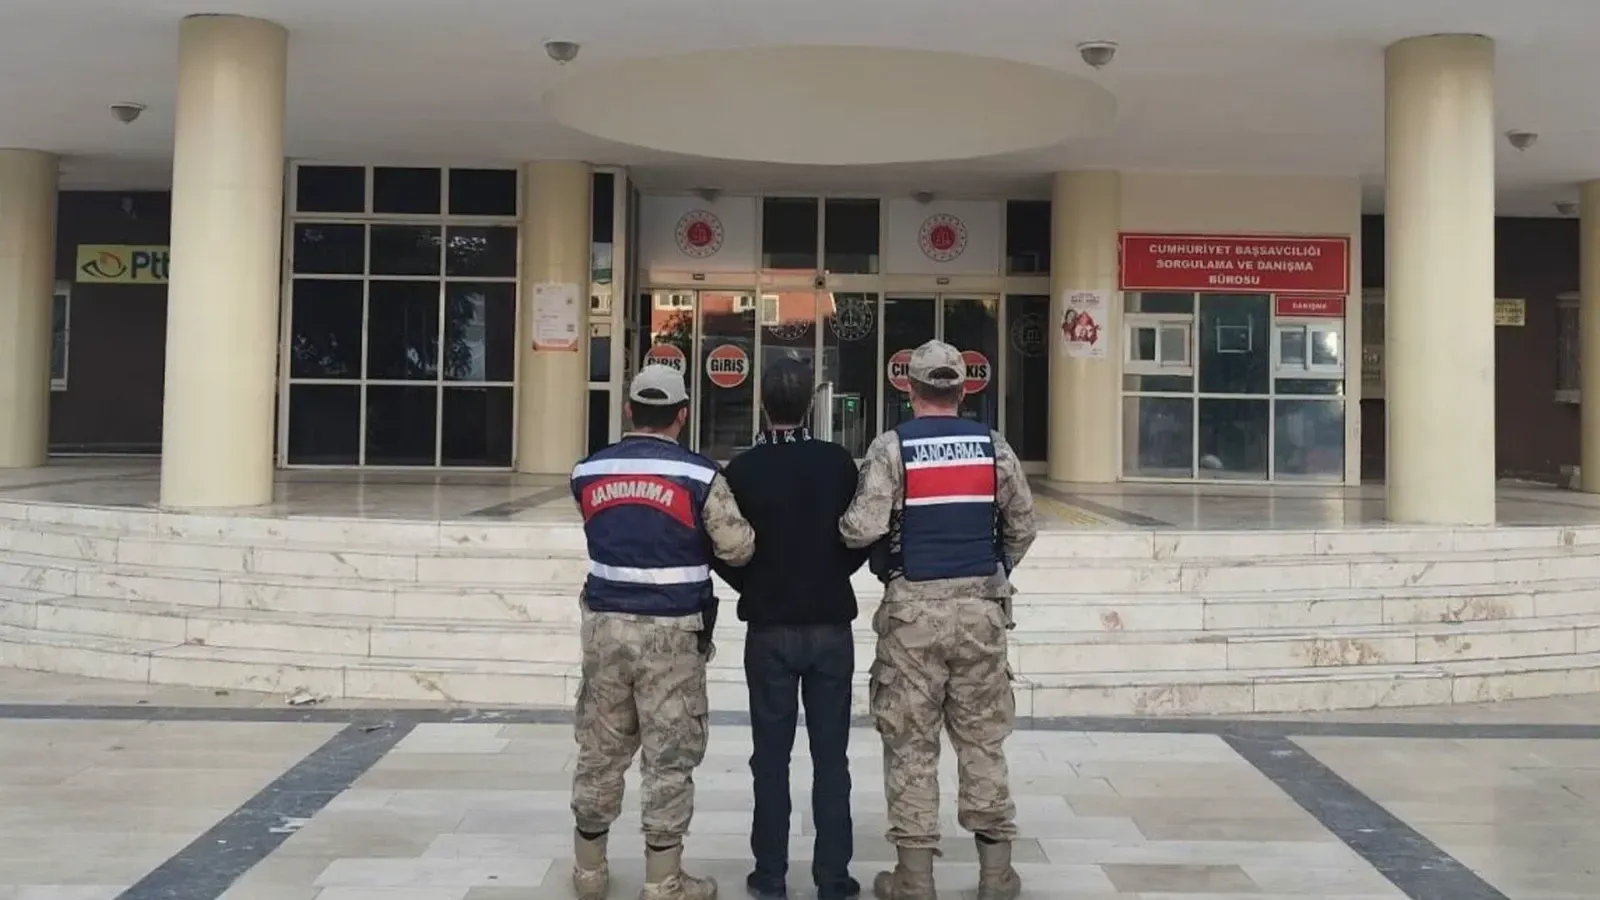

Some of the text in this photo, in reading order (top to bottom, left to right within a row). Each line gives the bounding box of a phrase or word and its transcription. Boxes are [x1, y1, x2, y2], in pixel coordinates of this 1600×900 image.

[1149, 243, 1321, 257] CUMHURİYET BAŞSAVCILIĞI
[1156, 259, 1313, 272] SORGULAMA VE DANIŞMA
[1209, 273, 1260, 285] BÜROSU
[913, 442, 985, 464] JANDARMA
[591, 481, 674, 506] JANDARMA
